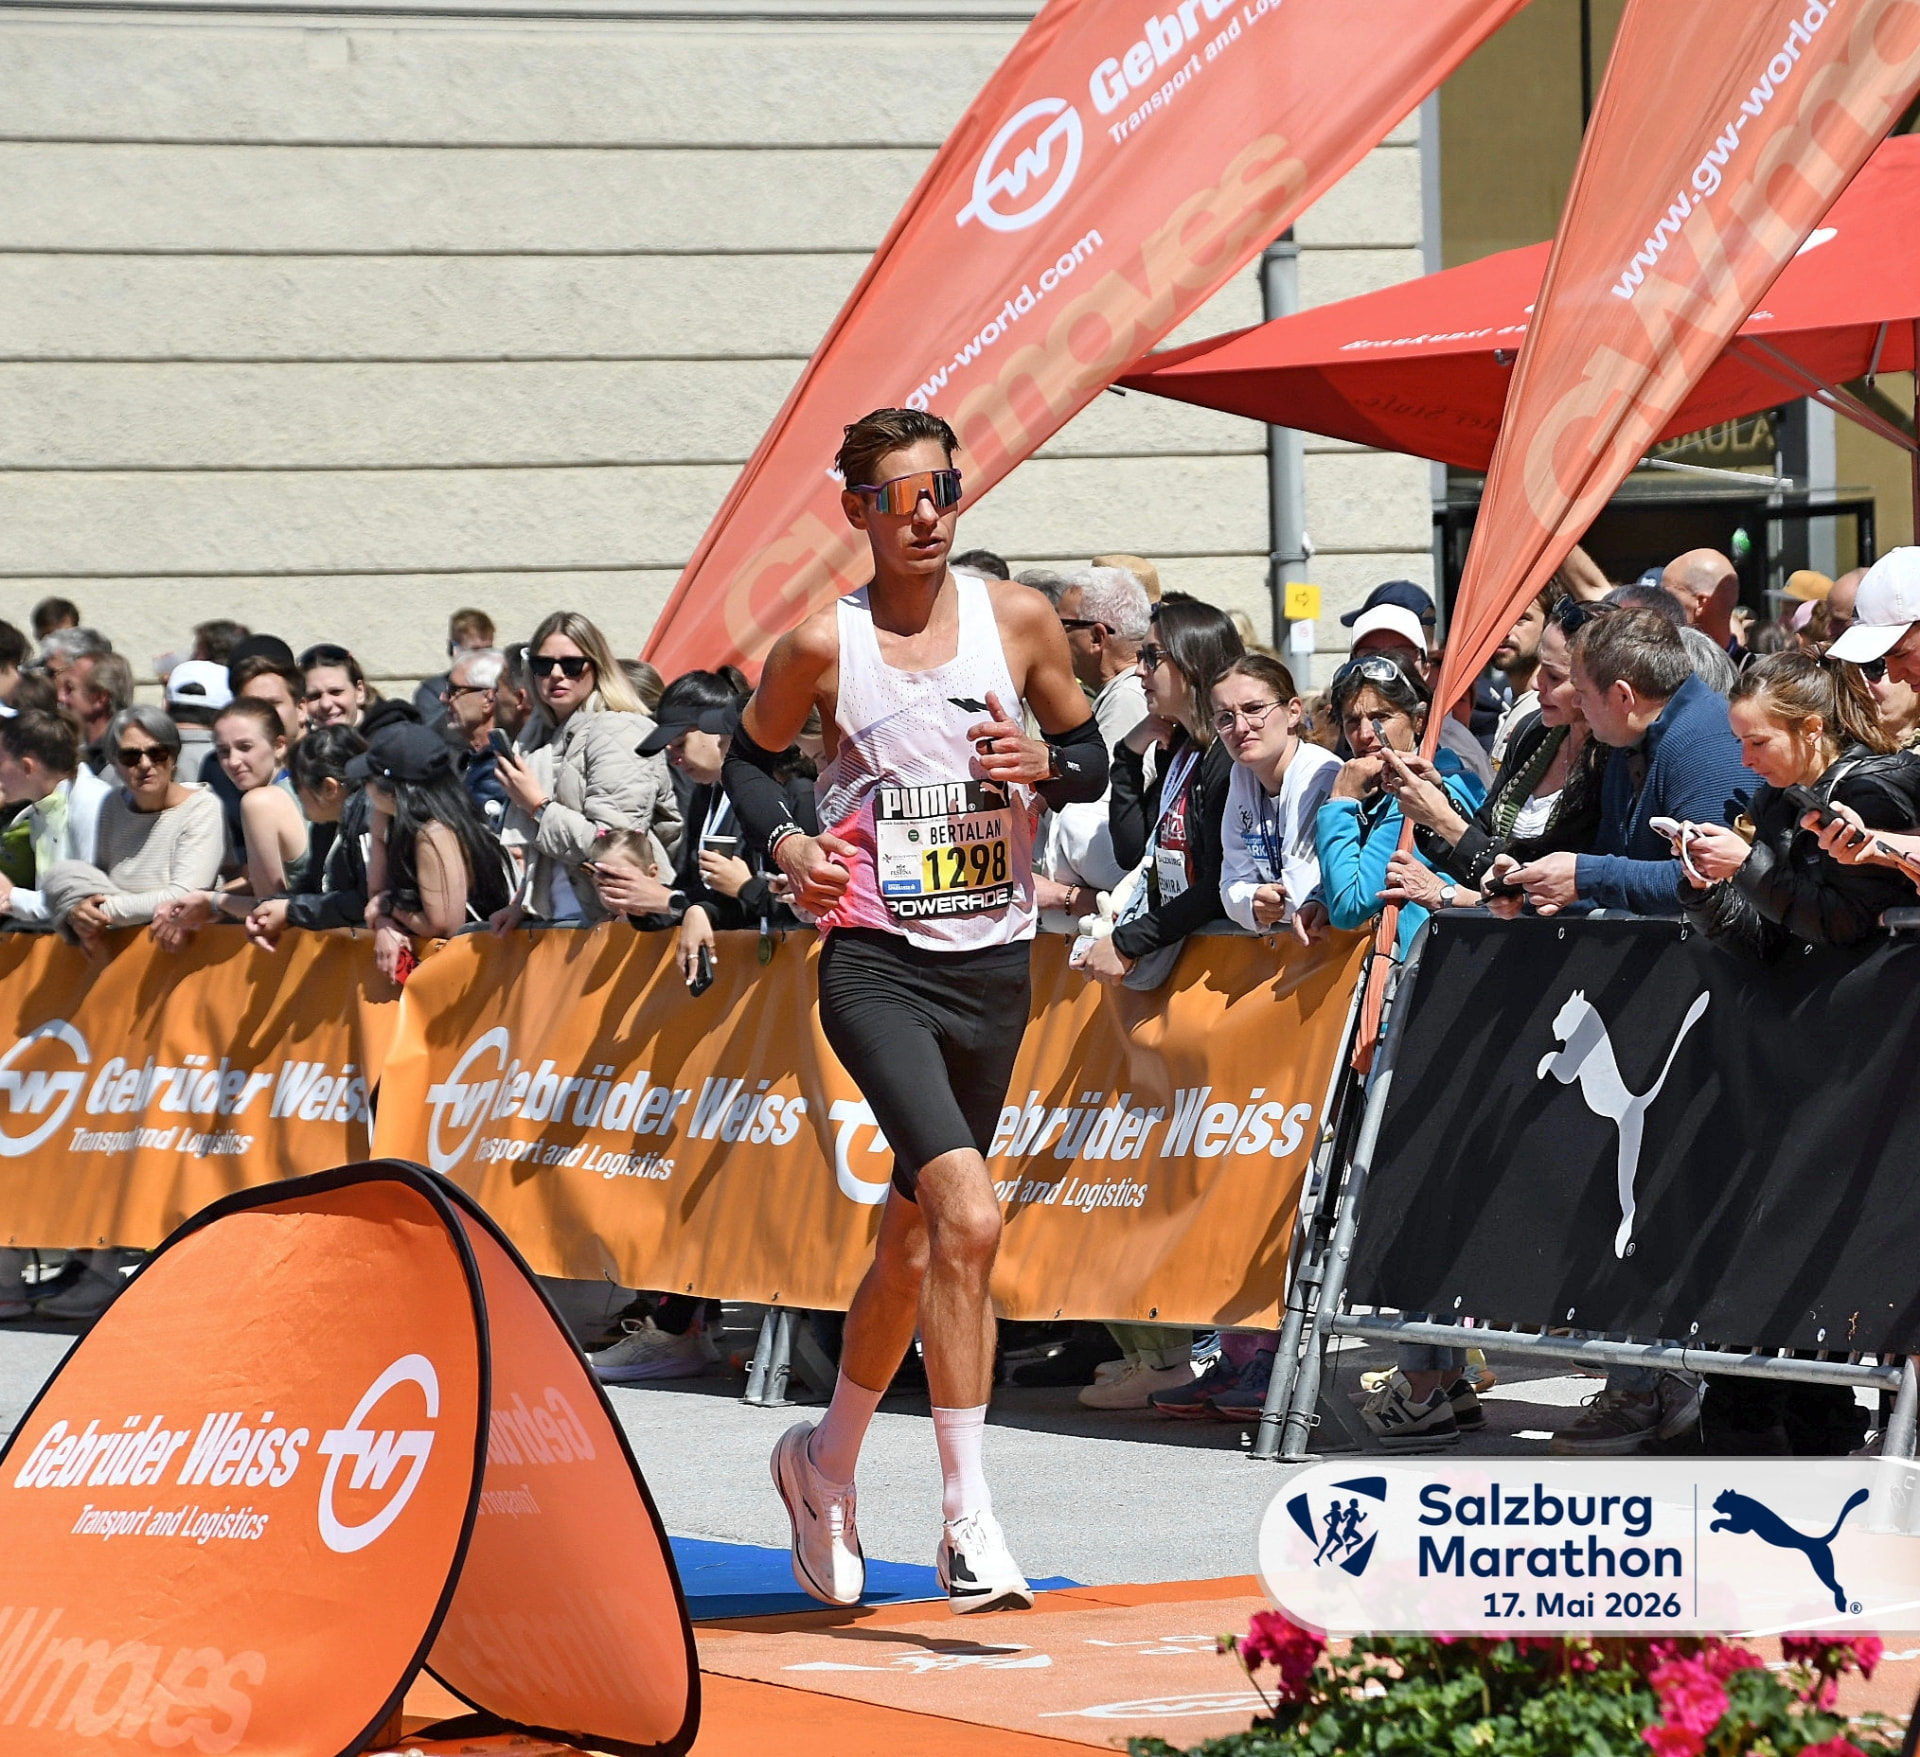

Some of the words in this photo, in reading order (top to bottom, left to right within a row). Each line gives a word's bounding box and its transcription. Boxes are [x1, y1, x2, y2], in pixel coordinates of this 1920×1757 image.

[1108, 53, 1202, 145] Transport
[1203, 16, 1242, 62] and
[881, 783, 967, 819] PUMA
[930, 817, 1001, 845] BERTALAN
[925, 840, 1007, 891] 1298
[686, 1076, 809, 1147] Weiss
[986, 1090, 1166, 1161] ebrüder
[1159, 1086, 1313, 1159] Weiss
[541, 1143, 588, 1168] and
[582, 1145, 677, 1180] Logistics
[1019, 1176, 1068, 1206] and
[1061, 1177, 1149, 1214] Logistics
[13, 1415, 191, 1489] Gebrüder
[176, 1411, 311, 1488] Weiss
[70, 1504, 154, 1542] Transport
[145, 1505, 190, 1537] and
[180, 1505, 270, 1545] Logistics
